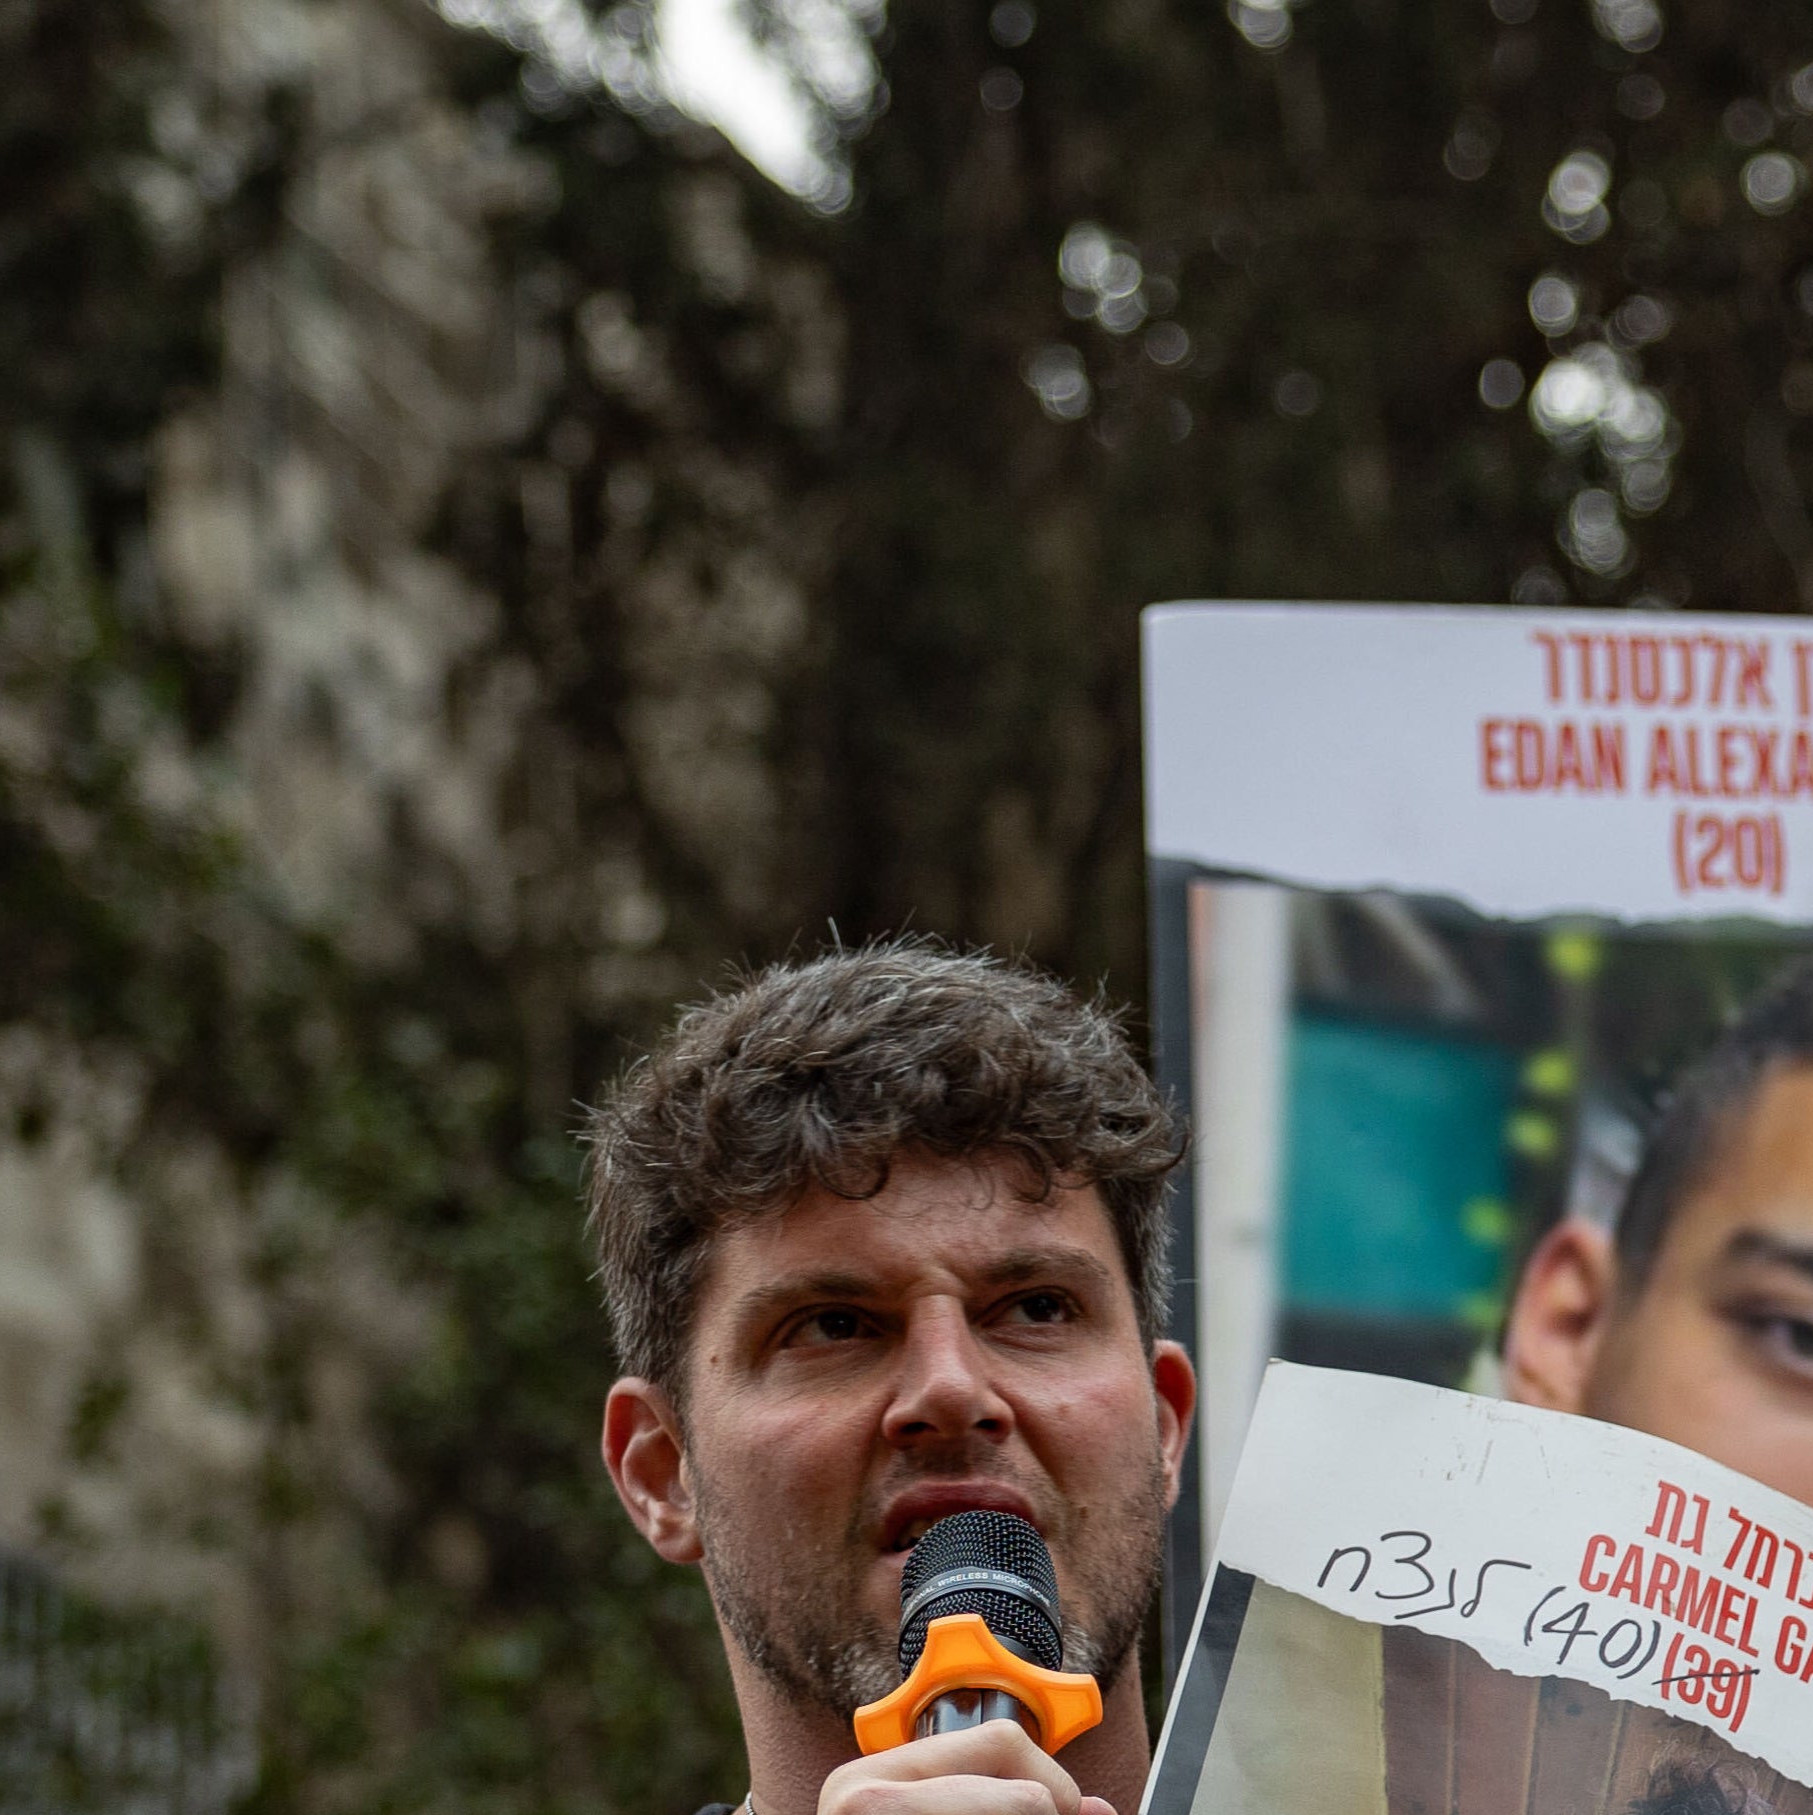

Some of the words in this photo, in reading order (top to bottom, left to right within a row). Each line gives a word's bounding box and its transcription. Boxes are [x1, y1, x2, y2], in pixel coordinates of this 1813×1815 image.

[1533, 631, 1776, 710] אלכסנדר
[1480, 719, 1626, 792] EDAN
[1672, 810, 1788, 896] (20)
[1645, 1480, 1710, 1555] גת
[937, 1571, 989, 1588] WIRELESS
[1579, 1534, 1760, 1658] CARMEL
[1523, 1586, 1660, 1680] (40)
[1660, 1632, 1753, 1733] (39)
